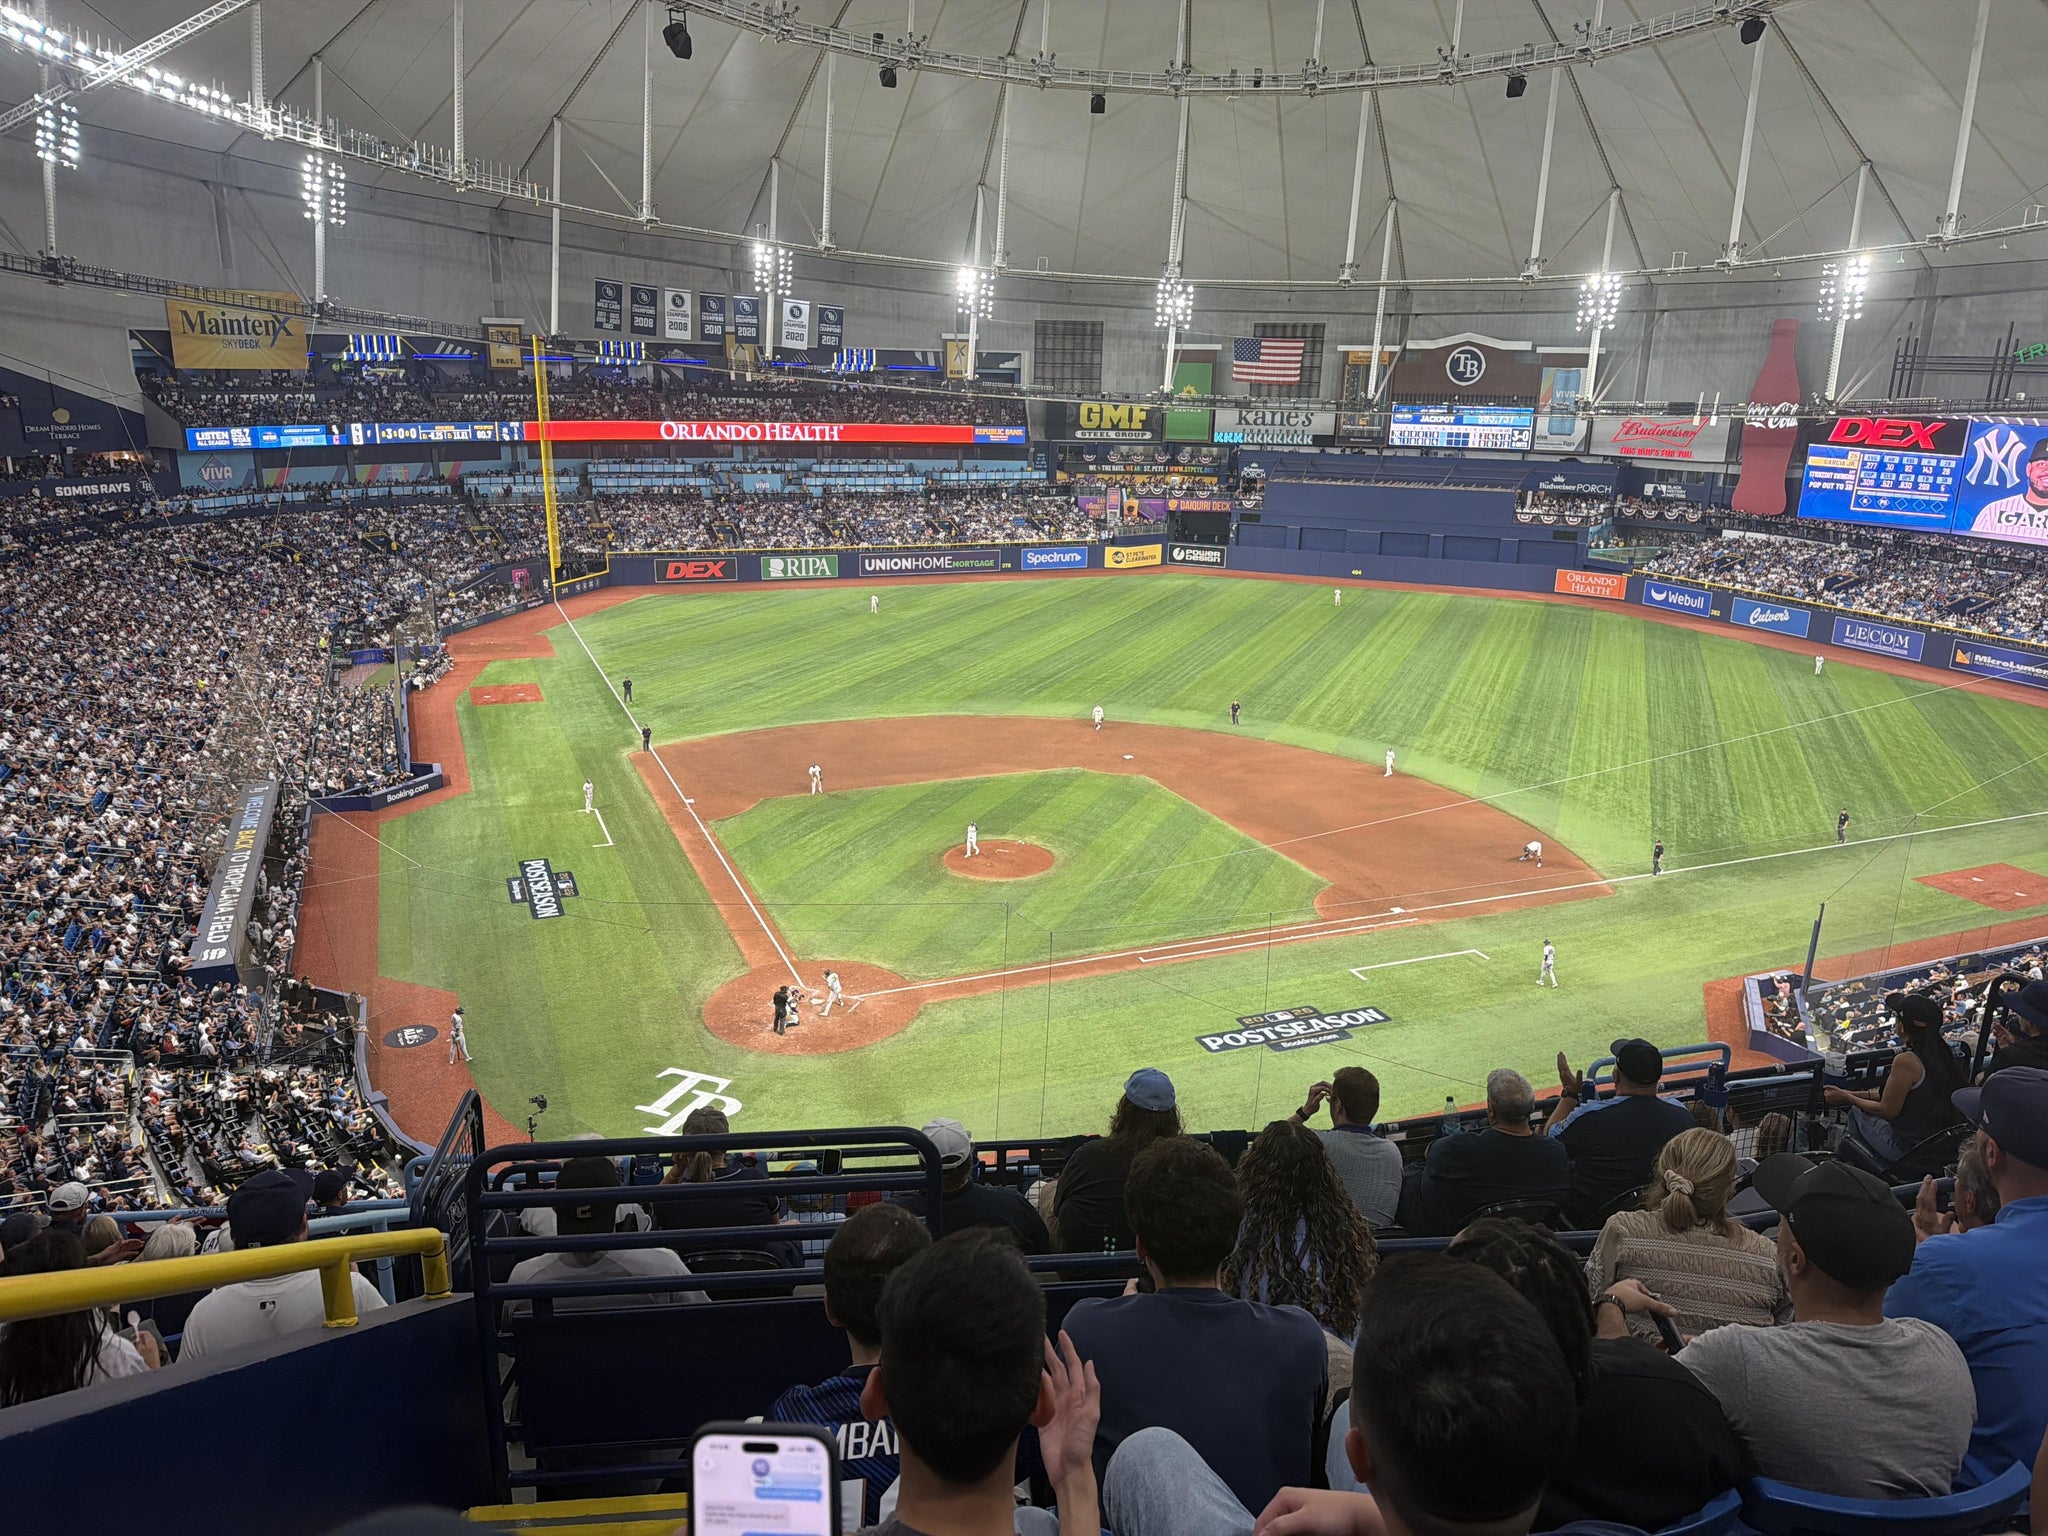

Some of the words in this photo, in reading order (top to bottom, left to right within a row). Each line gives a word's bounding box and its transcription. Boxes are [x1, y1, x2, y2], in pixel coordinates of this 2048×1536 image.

[178, 309, 294, 348] MaintenX
[634, 317, 653, 327] 2008
[669, 321, 687, 331] 2008
[704, 325, 721, 334] 2010
[738, 327, 756, 336] 2020
[786, 331, 804, 341] 2020
[822, 336, 839, 345] 2021
[1455, 354, 1478, 378] TB
[1080, 403, 1147, 429] GMF
[1236, 409, 1315, 427] kane's
[1420, 414, 1455, 424] JACKPOT
[25, 425, 49, 433] DREAM
[51, 424, 77, 432] FINDERS
[78, 423, 101, 431] HOMES
[660, 421, 761, 440] ORLANDO
[764, 422, 840, 440] HEALTH
[975, 428, 1003, 436] REPUBLIC
[1624, 422, 1697, 438] Budweiser
[1828, 417, 1947, 449] DEX
[50, 432, 80, 440] TERRACE
[196, 431, 228, 441] LISTEN
[1619, 446, 1634, 454] THIS
[1661, 449, 1675, 457] FOR
[1678, 450, 1694, 459] YOU.
[201, 466, 232, 480] VIVA
[1241, 471, 1266, 479] PORCH
[55, 485, 98, 497] SOMOS
[100, 483, 131, 494] RAYS
[1539, 482, 1576, 492] Budweiser
[1577, 484, 1612, 494] PORCH
[1180, 499, 1210, 510] DAIQUIRI
[1212, 501, 1231, 511] DECK
[2000, 511, 2048, 529] GAR
[952, 560, 994, 568] MORTGAGE
[1027, 552, 1076, 566] Spectrum
[1126, 554, 1157, 563] CLEARWATER
[666, 561, 726, 579] DEX
[786, 558, 831, 576] RIPA
[1567, 573, 1617, 586] ORLANDO
[1571, 583, 1612, 596] HEALTH
[1668, 591, 1704, 609] Webull
[1750, 608, 1790, 624] Culver's
[387, 784, 429, 802] Booking.com
[240, 795, 265, 829] WELCOME
[234, 829, 257, 850] BACK
[230, 850, 251, 862] TO
[215, 862, 248, 914] TROPICANA
[524, 859, 559, 918] POSTSEASON
[206, 915, 234, 943] FIELD
[1202, 1009, 1385, 1050] POSTSEASON
[1281, 1033, 1339, 1048] Booking.com
